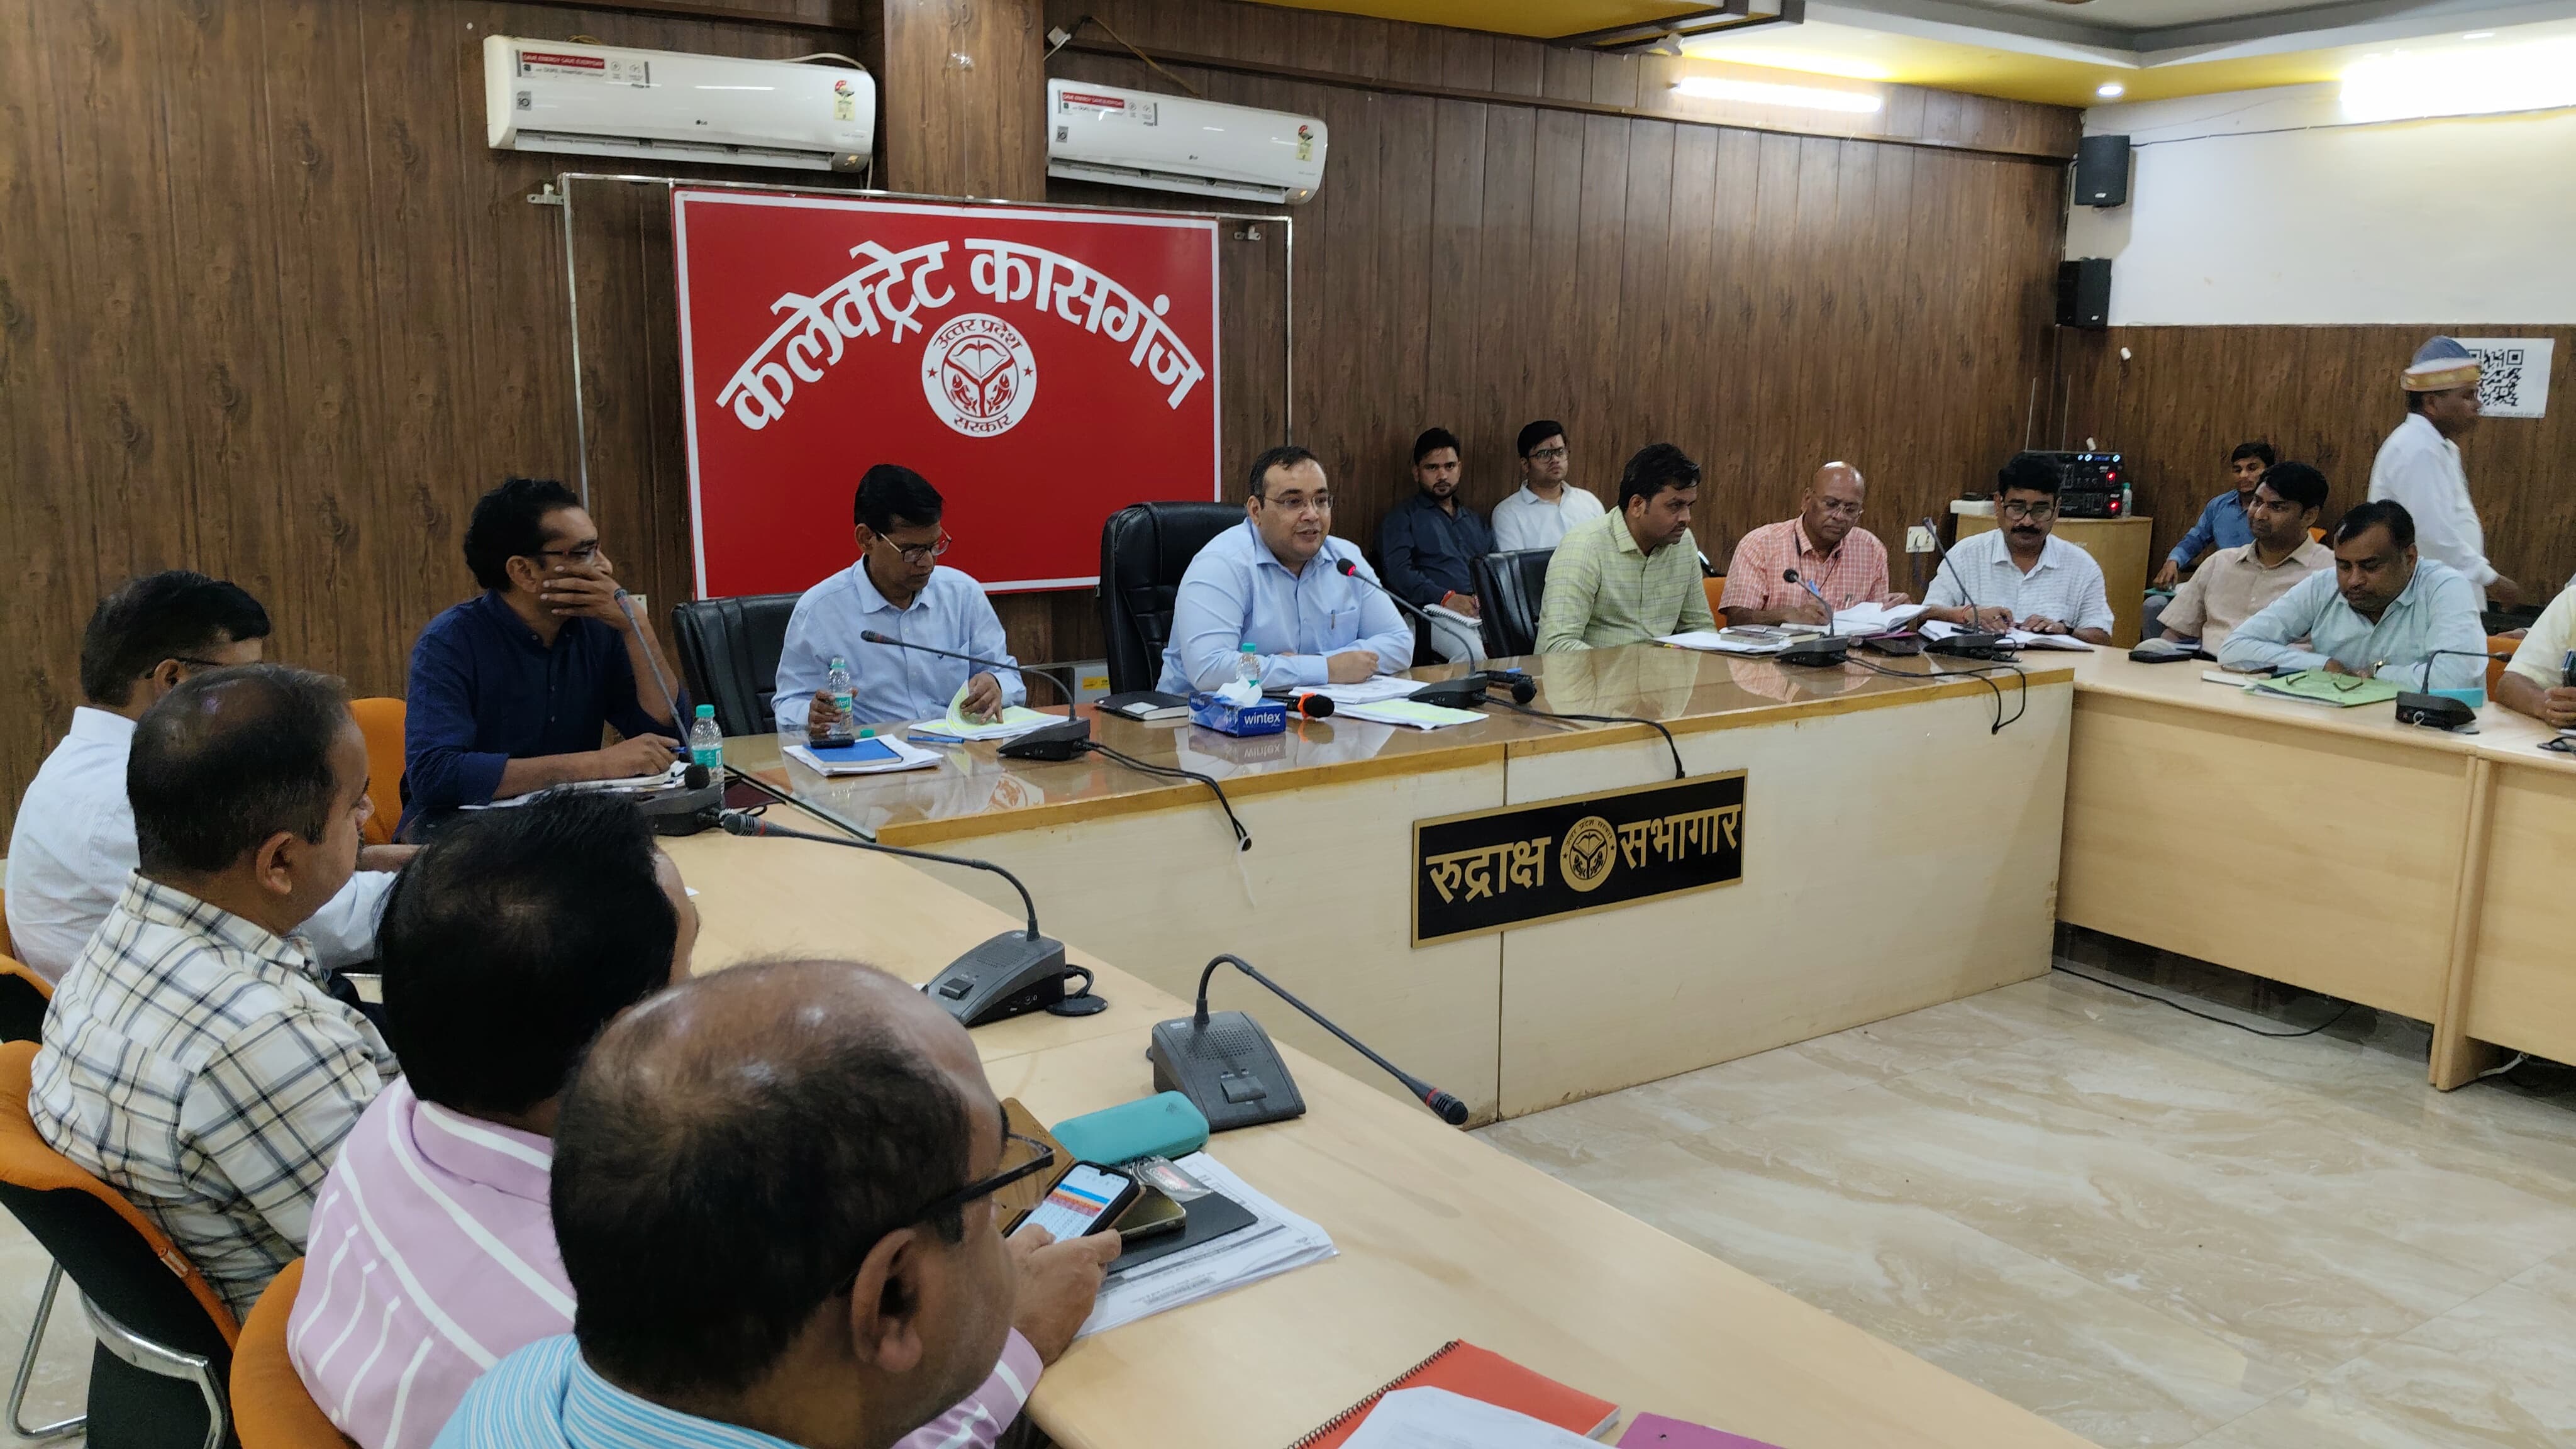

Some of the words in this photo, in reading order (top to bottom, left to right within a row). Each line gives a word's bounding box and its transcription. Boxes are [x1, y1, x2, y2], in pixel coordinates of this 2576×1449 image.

[716, 240, 956, 430] कलेक्ट्रेट
[964, 238, 1206, 410] कासगंज
[933, 319, 977, 350] उत्तर
[980, 319, 1023, 350] प्रदेश
[953, 413, 1013, 433] सरकार
[1244, 711, 1281, 725] wintex
[1426, 836, 1552, 904] रुद्राक्ष
[1618, 804, 1742, 869] सभागार
